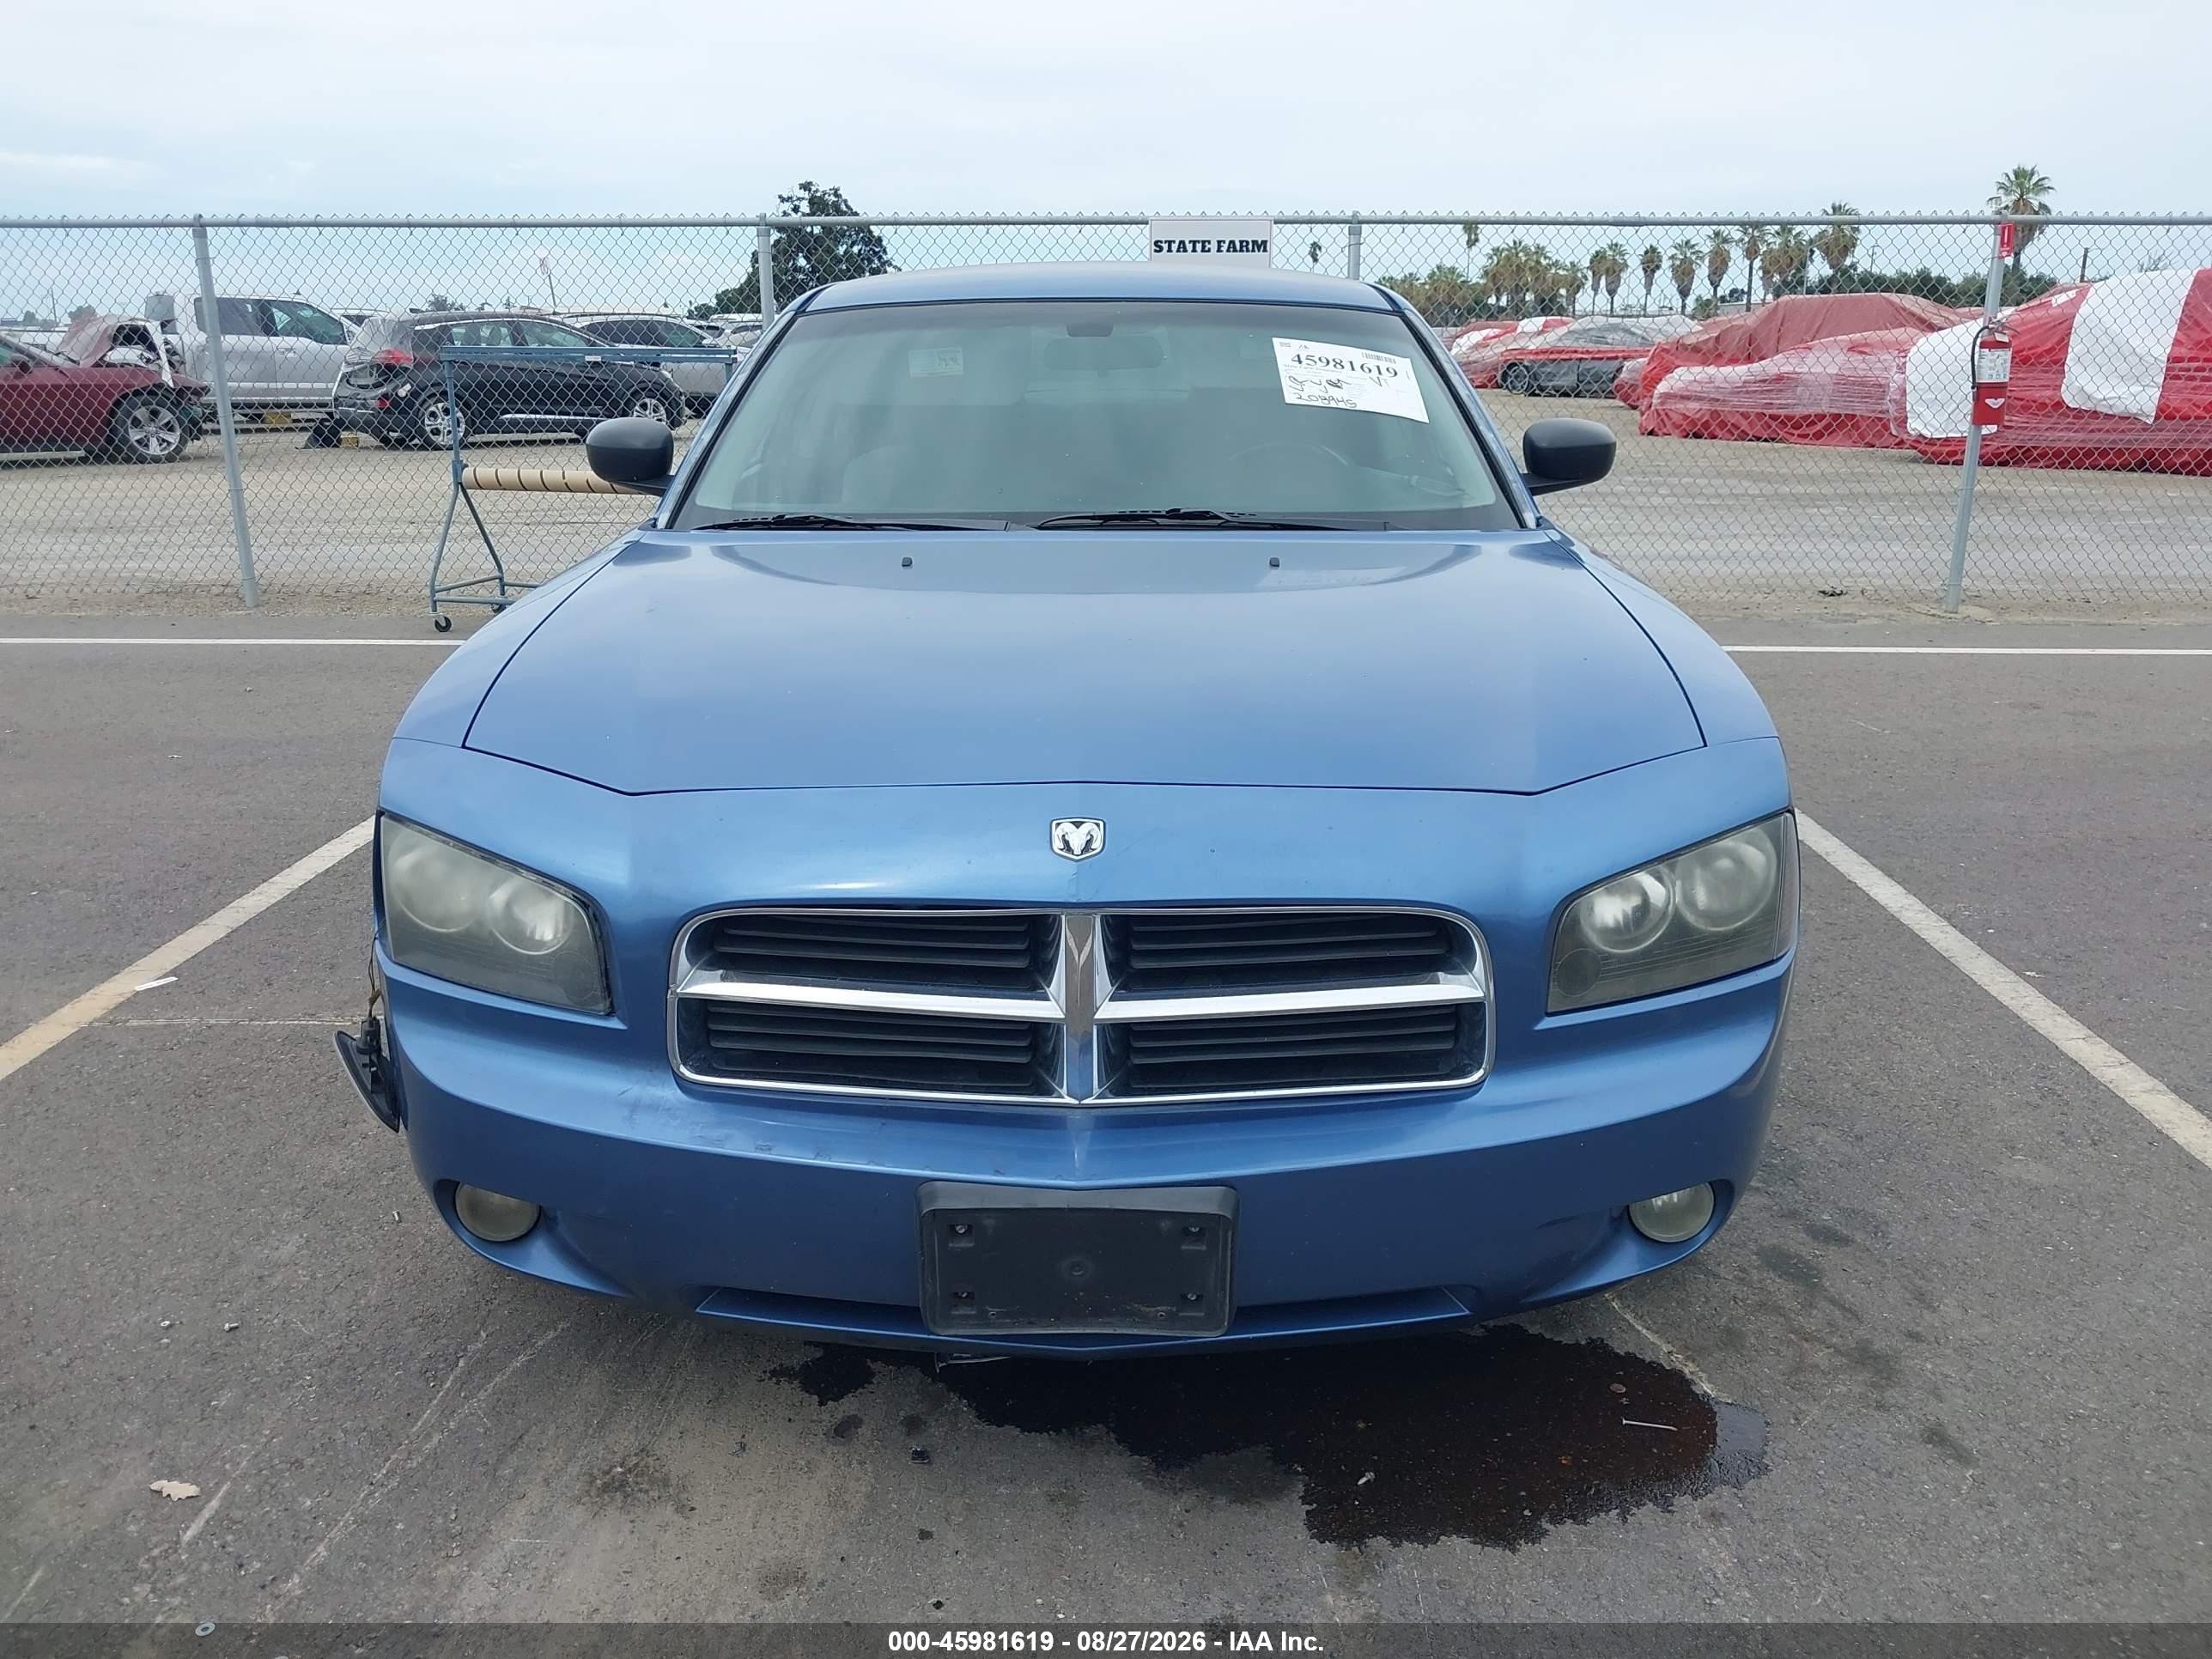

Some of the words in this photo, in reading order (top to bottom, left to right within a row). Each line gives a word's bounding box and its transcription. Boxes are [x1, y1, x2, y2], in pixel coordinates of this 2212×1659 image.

[1153, 240, 1212, 253] STATE
[1216, 240, 1268, 253] FARM
[1291, 354, 1398, 378] 45981619
